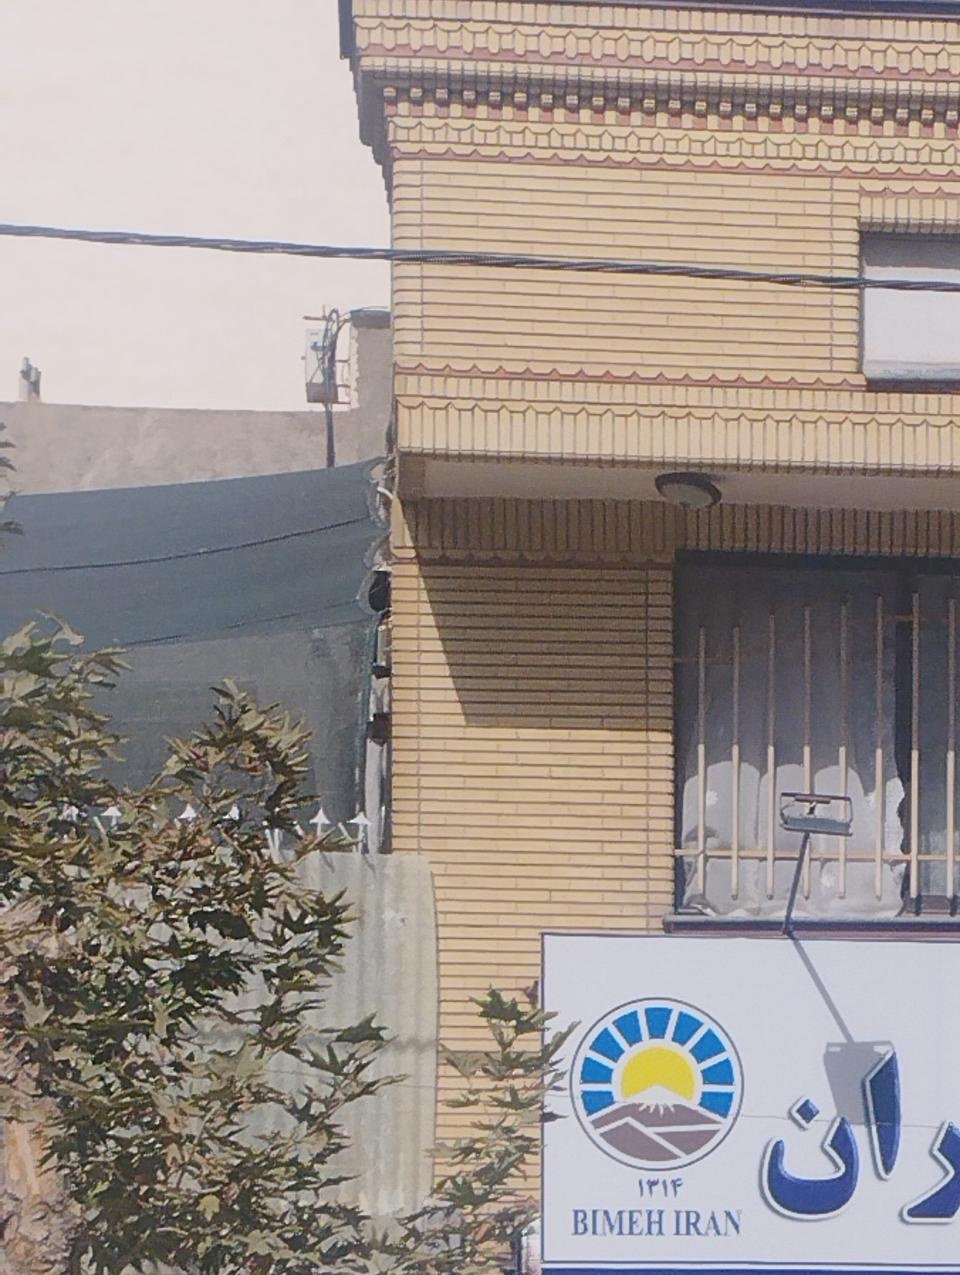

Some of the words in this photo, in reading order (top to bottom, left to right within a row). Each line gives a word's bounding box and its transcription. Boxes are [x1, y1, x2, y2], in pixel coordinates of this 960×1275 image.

[638, 1177, 684, 1198] ۱۳۱۴
[572, 1209, 665, 1237] BIMEH
[673, 1209, 743, 1237] IRAN
